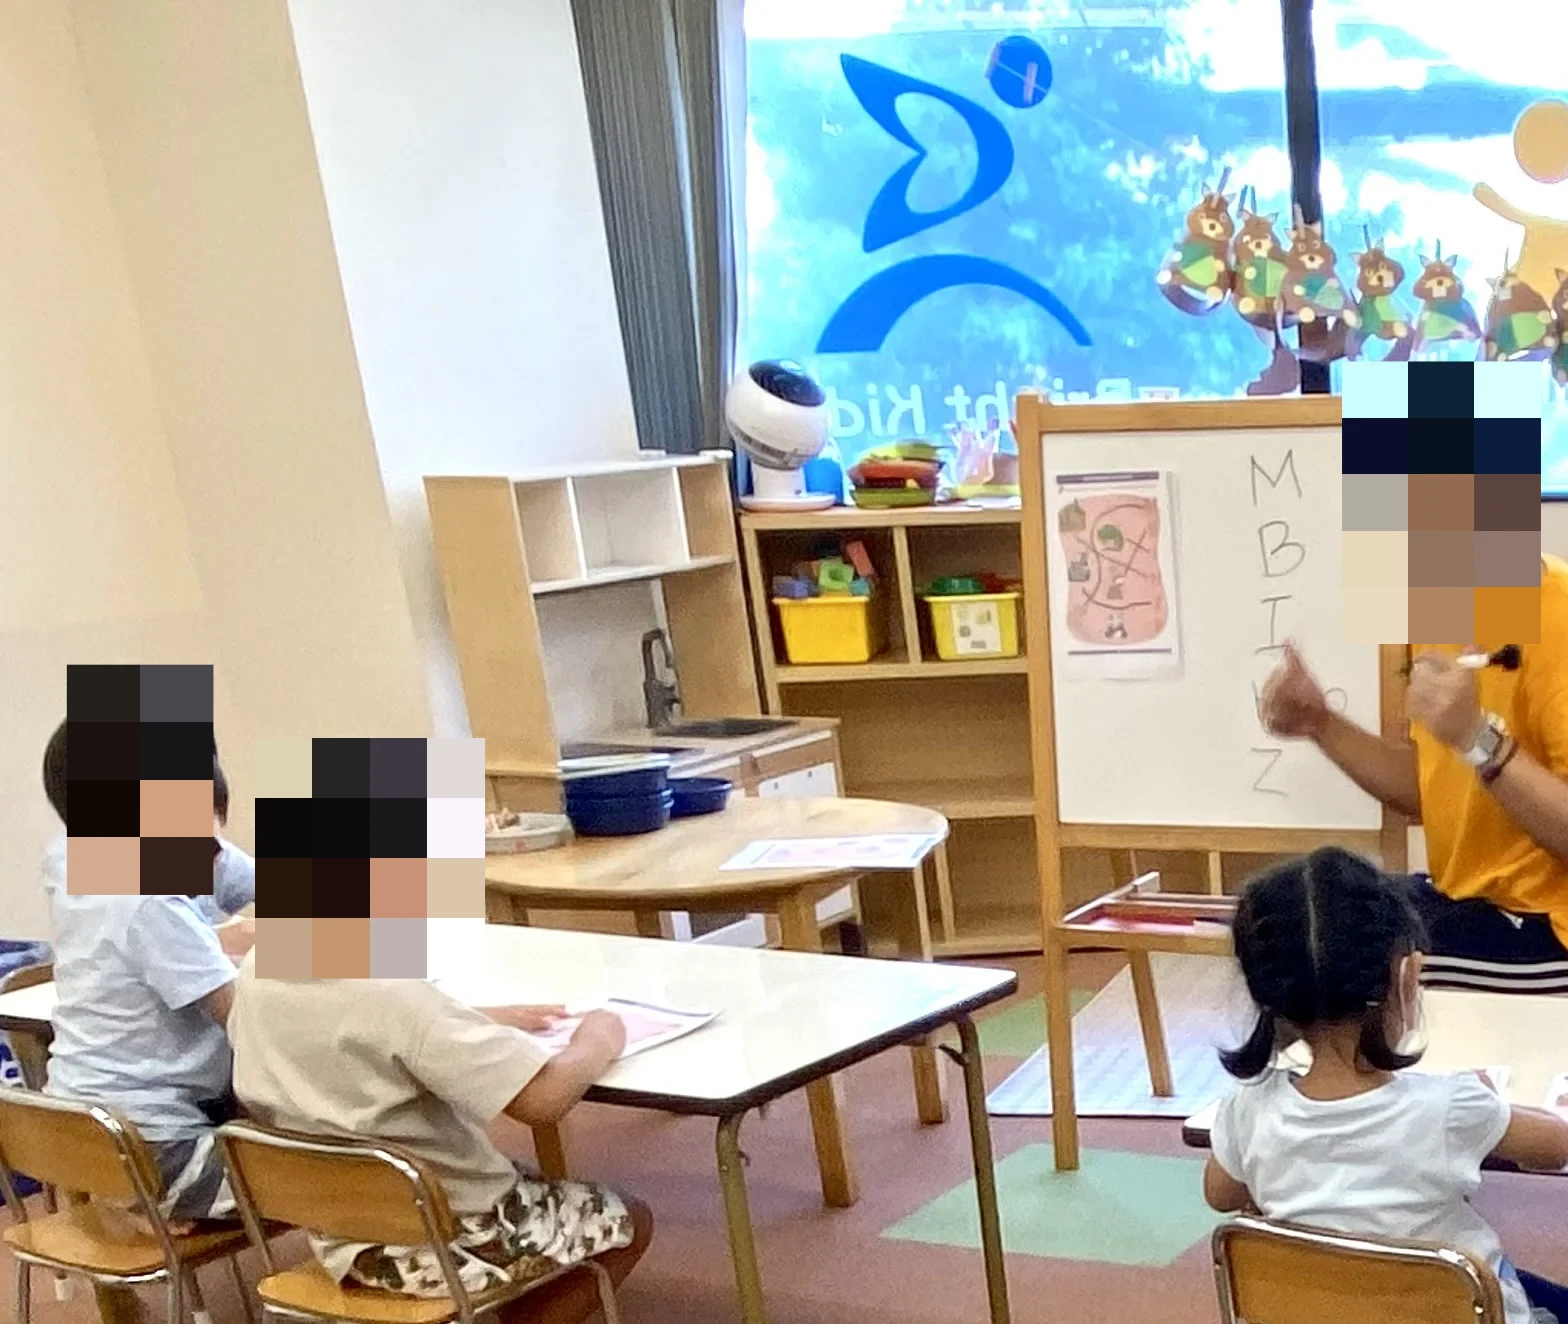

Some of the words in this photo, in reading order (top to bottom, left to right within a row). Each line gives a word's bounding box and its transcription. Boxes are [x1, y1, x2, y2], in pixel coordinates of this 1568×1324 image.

[1249, 448, 1303, 508] M
[1257, 519, 1306, 579] B
[1254, 594, 1293, 655] I
[1250, 747, 1290, 798] Z
